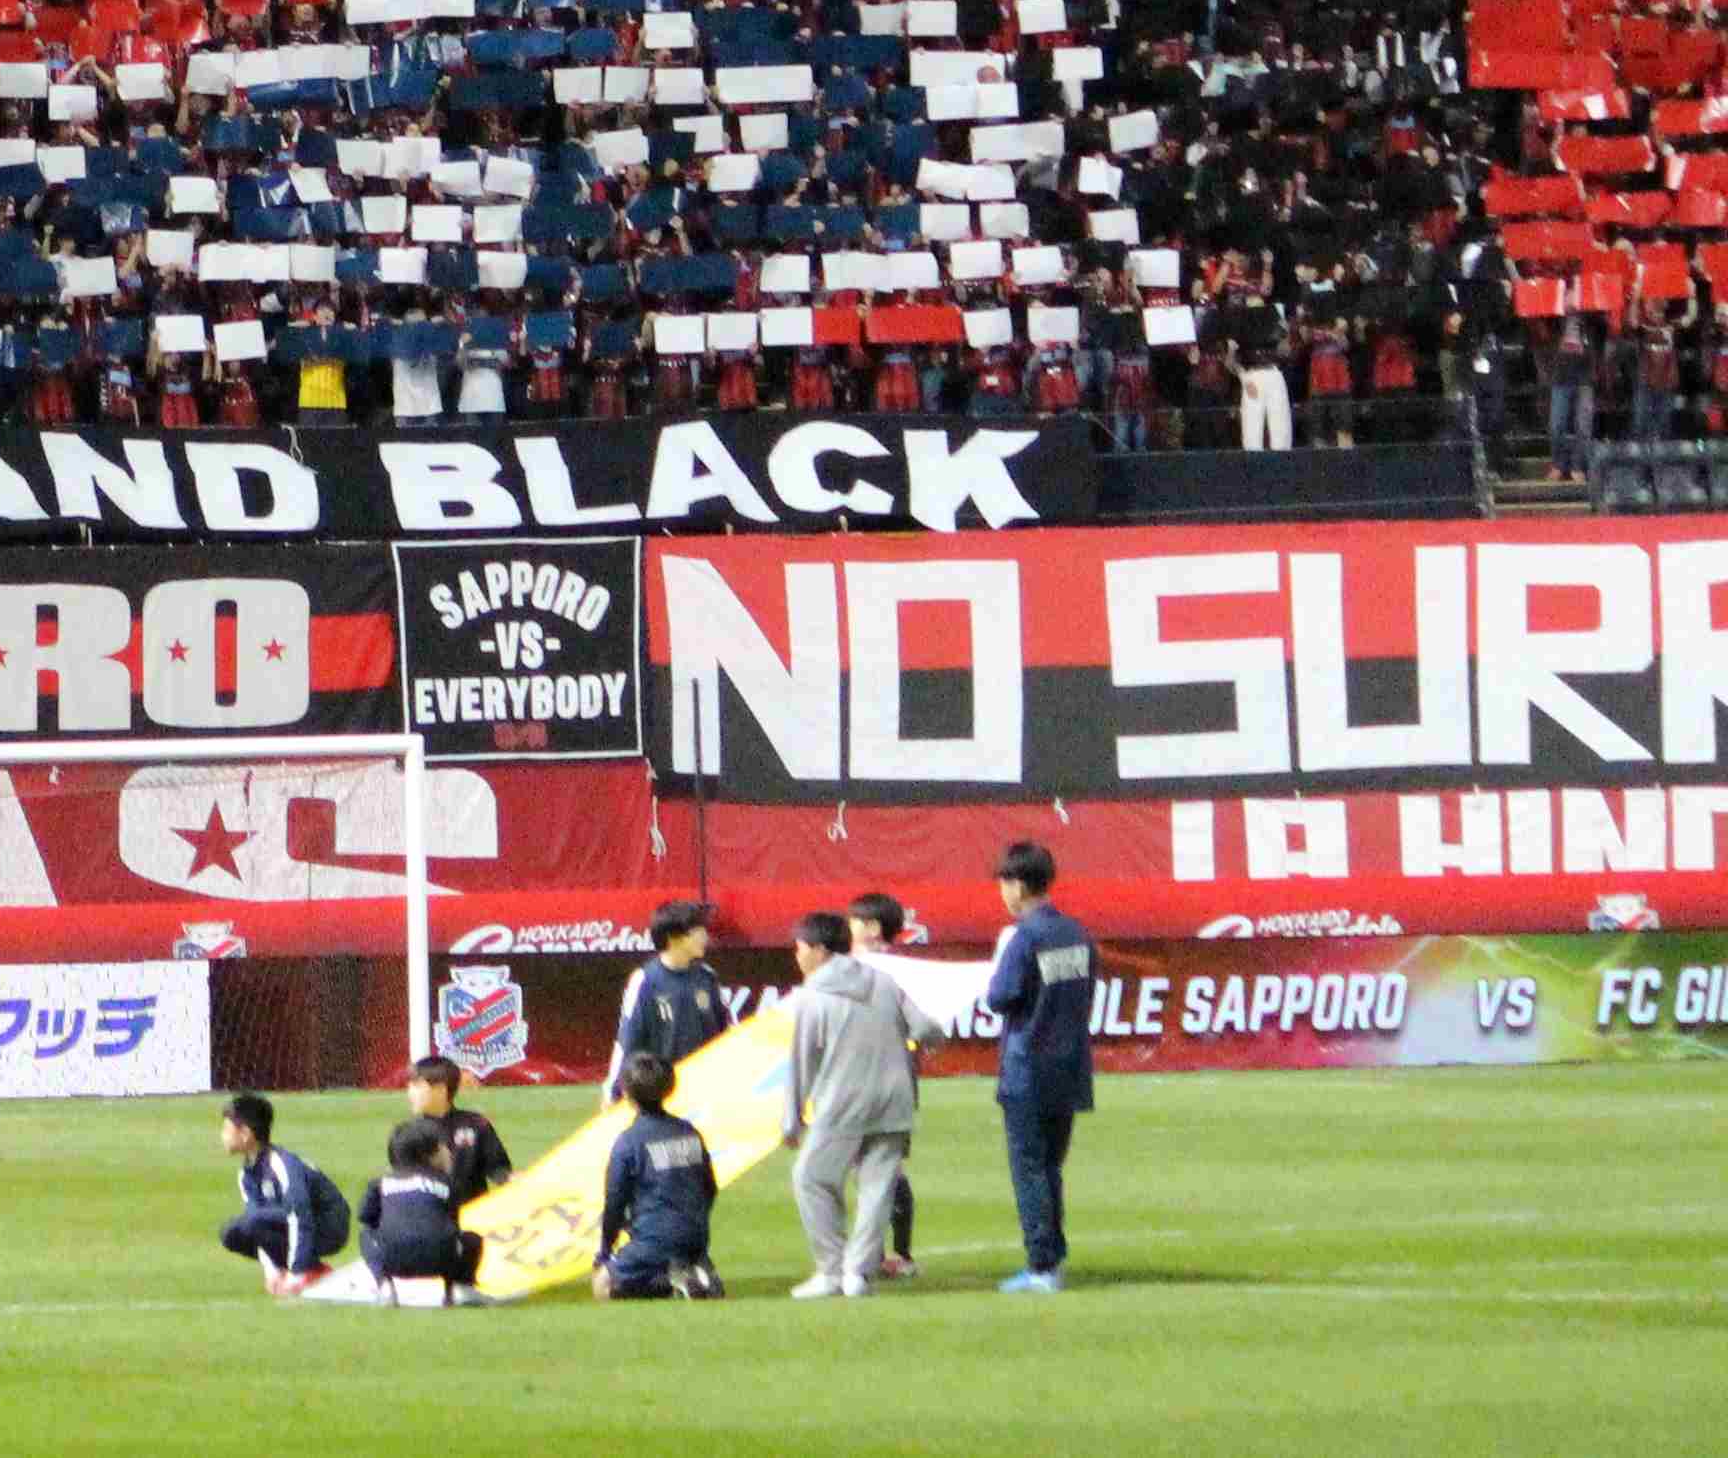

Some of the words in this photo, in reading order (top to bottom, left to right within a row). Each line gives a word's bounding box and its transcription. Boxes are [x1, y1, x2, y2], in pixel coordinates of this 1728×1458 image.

[378, 421, 1040, 532] BLACK
[429, 560, 611, 631] SAPPORO
[414, 672, 627, 724] EVERYBODY
[660, 551, 1024, 785] NO
[518, 920, 614, 943] HOKKAIDO
[1182, 972, 1408, 1034] SAPPORO
[1476, 976, 1537, 1029] VS
[1597, 966, 1662, 1026] FC
